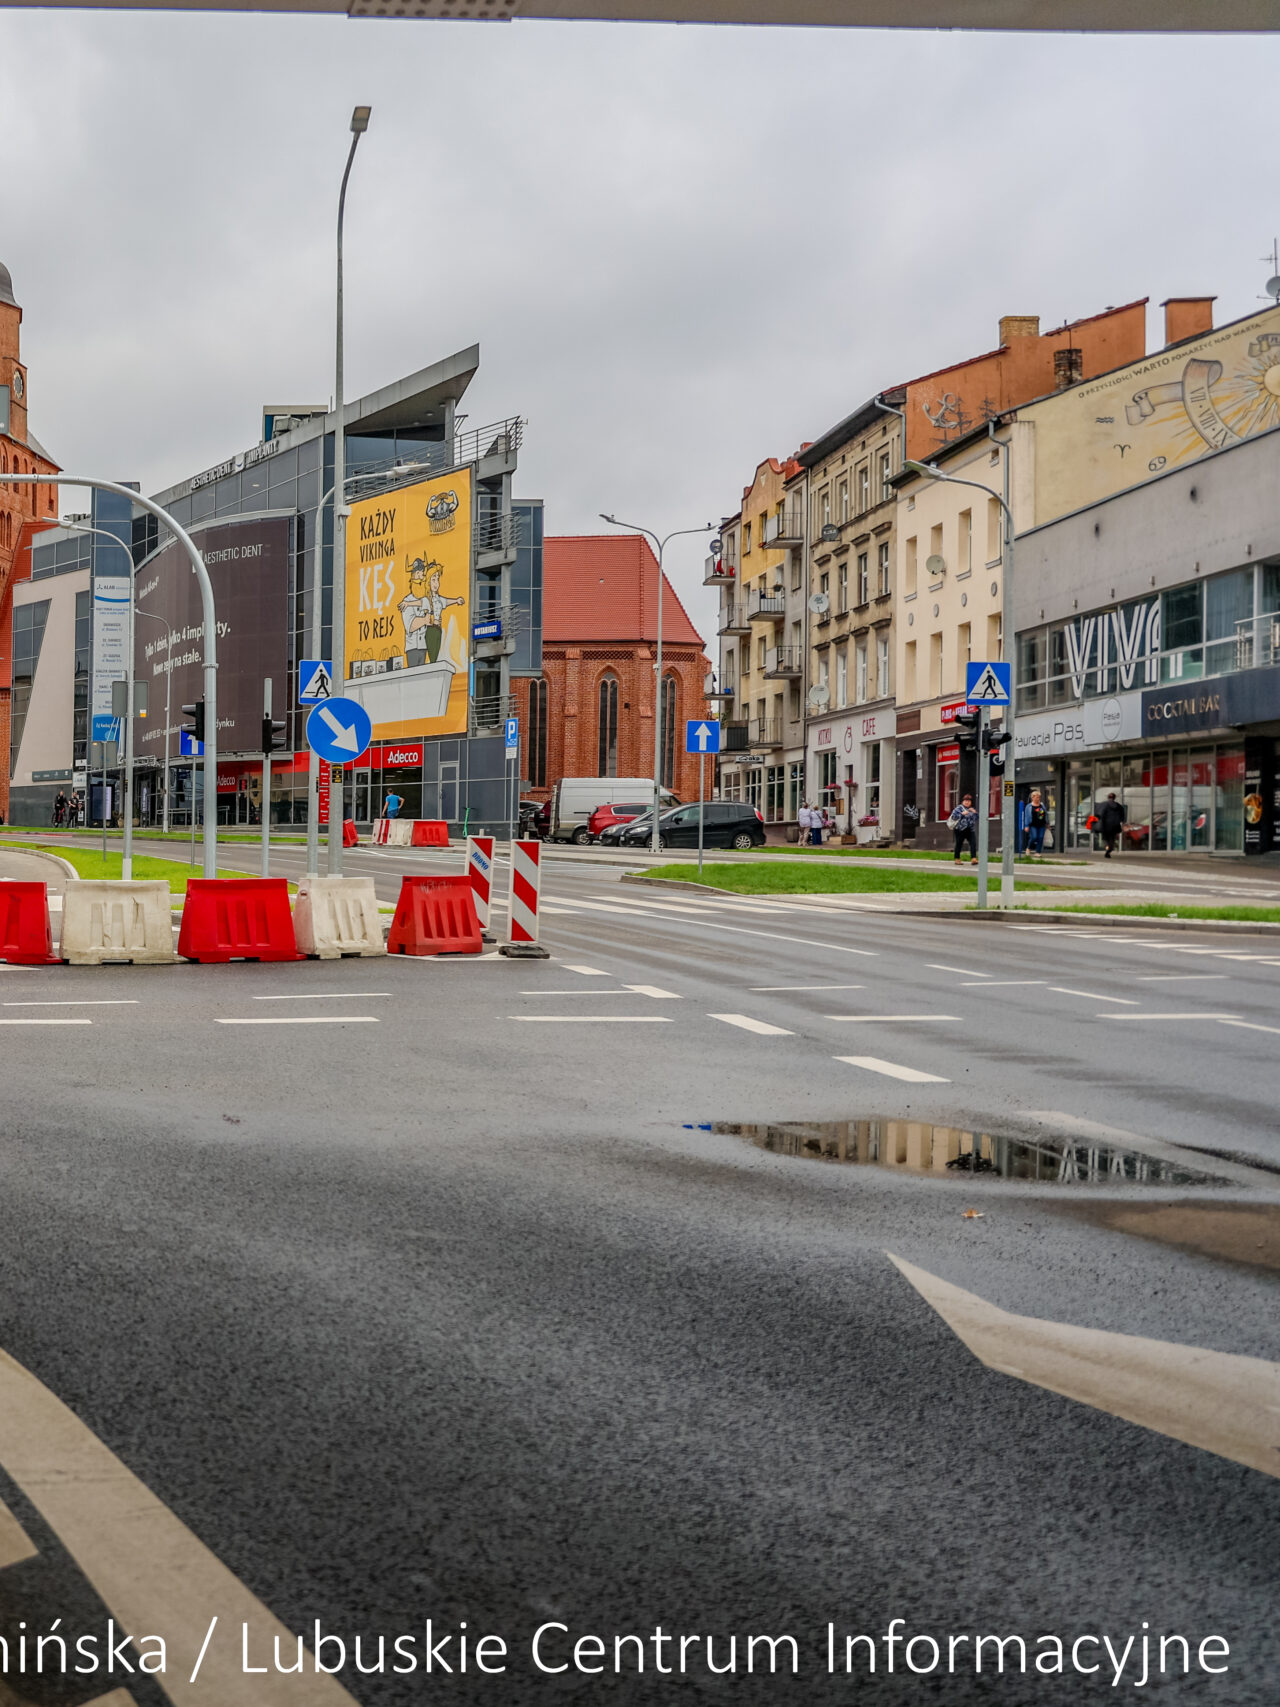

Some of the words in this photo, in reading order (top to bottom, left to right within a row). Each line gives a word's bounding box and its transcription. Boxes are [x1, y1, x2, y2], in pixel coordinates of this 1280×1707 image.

[1132, 357, 1171, 376] WARTO
[1214, 334, 1232, 346] NAD
[360, 508, 396, 541] KAŻDY
[203, 547, 239, 564] AESTHETIC
[241, 544, 263, 558] DENT
[360, 537, 396, 564] VIKINGA
[359, 560, 395, 615] KĘS
[182, 627, 186, 640] 4
[358, 620, 370, 642] TO
[372, 615, 395, 640] REJS
[174, 656, 182, 667] na
[182, 648, 202, 665] stałe.
[508, 721, 516, 739] P
[862, 717, 876, 737] CAFE
[1053, 722, 1085, 743] Pas
[387, 751, 418, 764] Adecco
